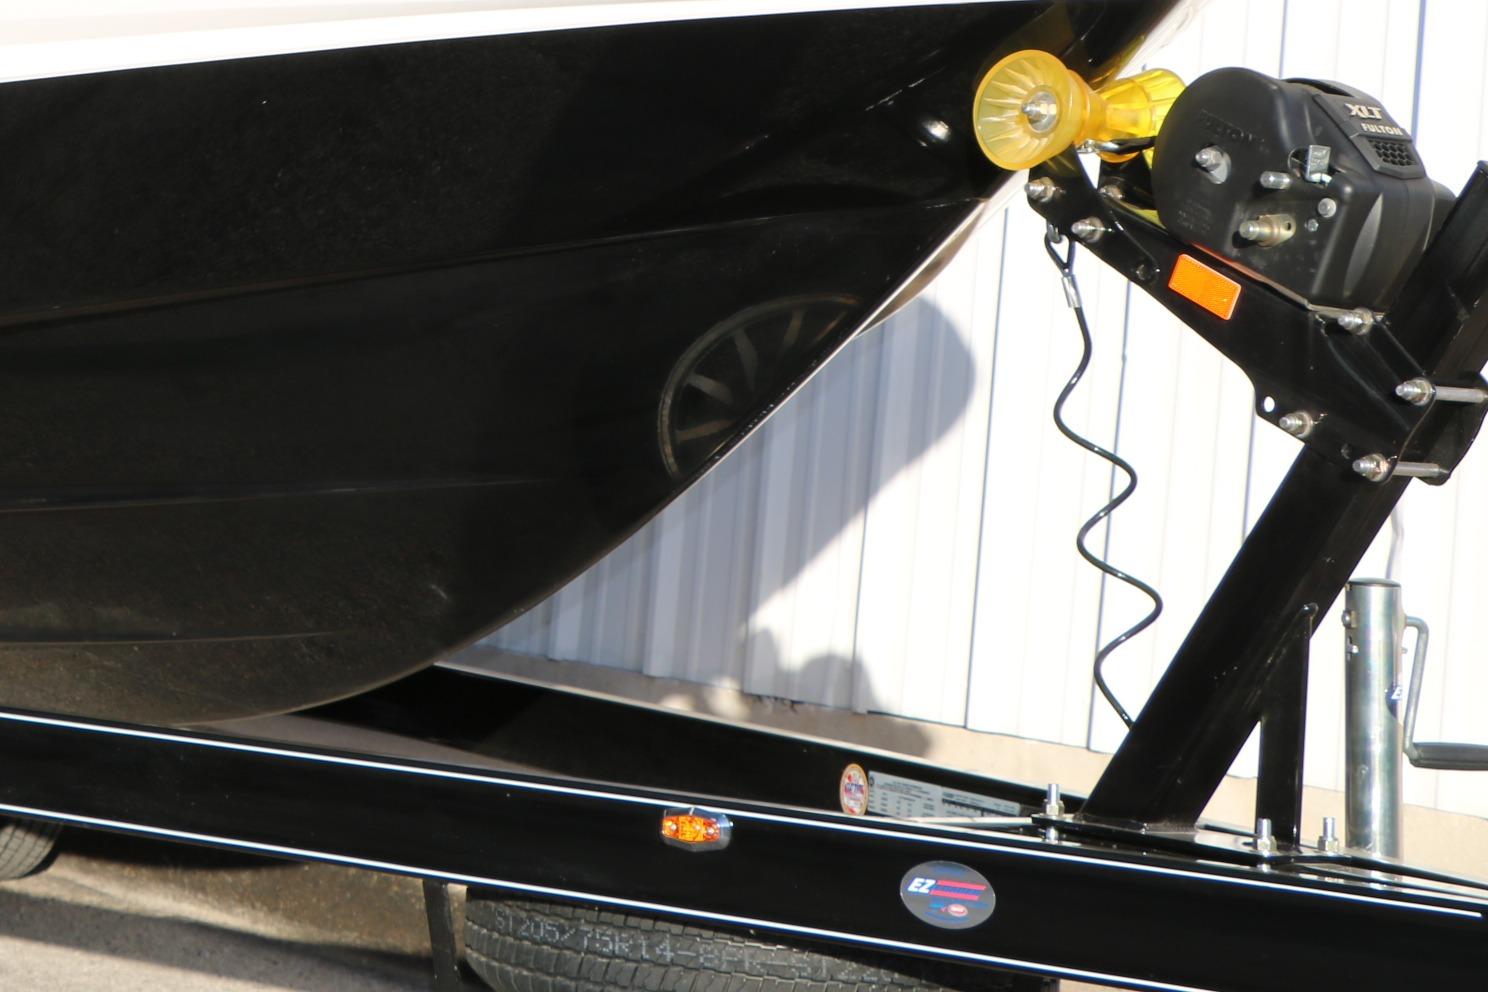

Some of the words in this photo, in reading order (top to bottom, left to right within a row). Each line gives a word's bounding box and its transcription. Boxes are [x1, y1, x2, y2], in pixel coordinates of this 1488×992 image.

[1344, 102, 1383, 120] XLT
[1360, 122, 1404, 136] FULTON
[907, 876, 937, 894] EZ
